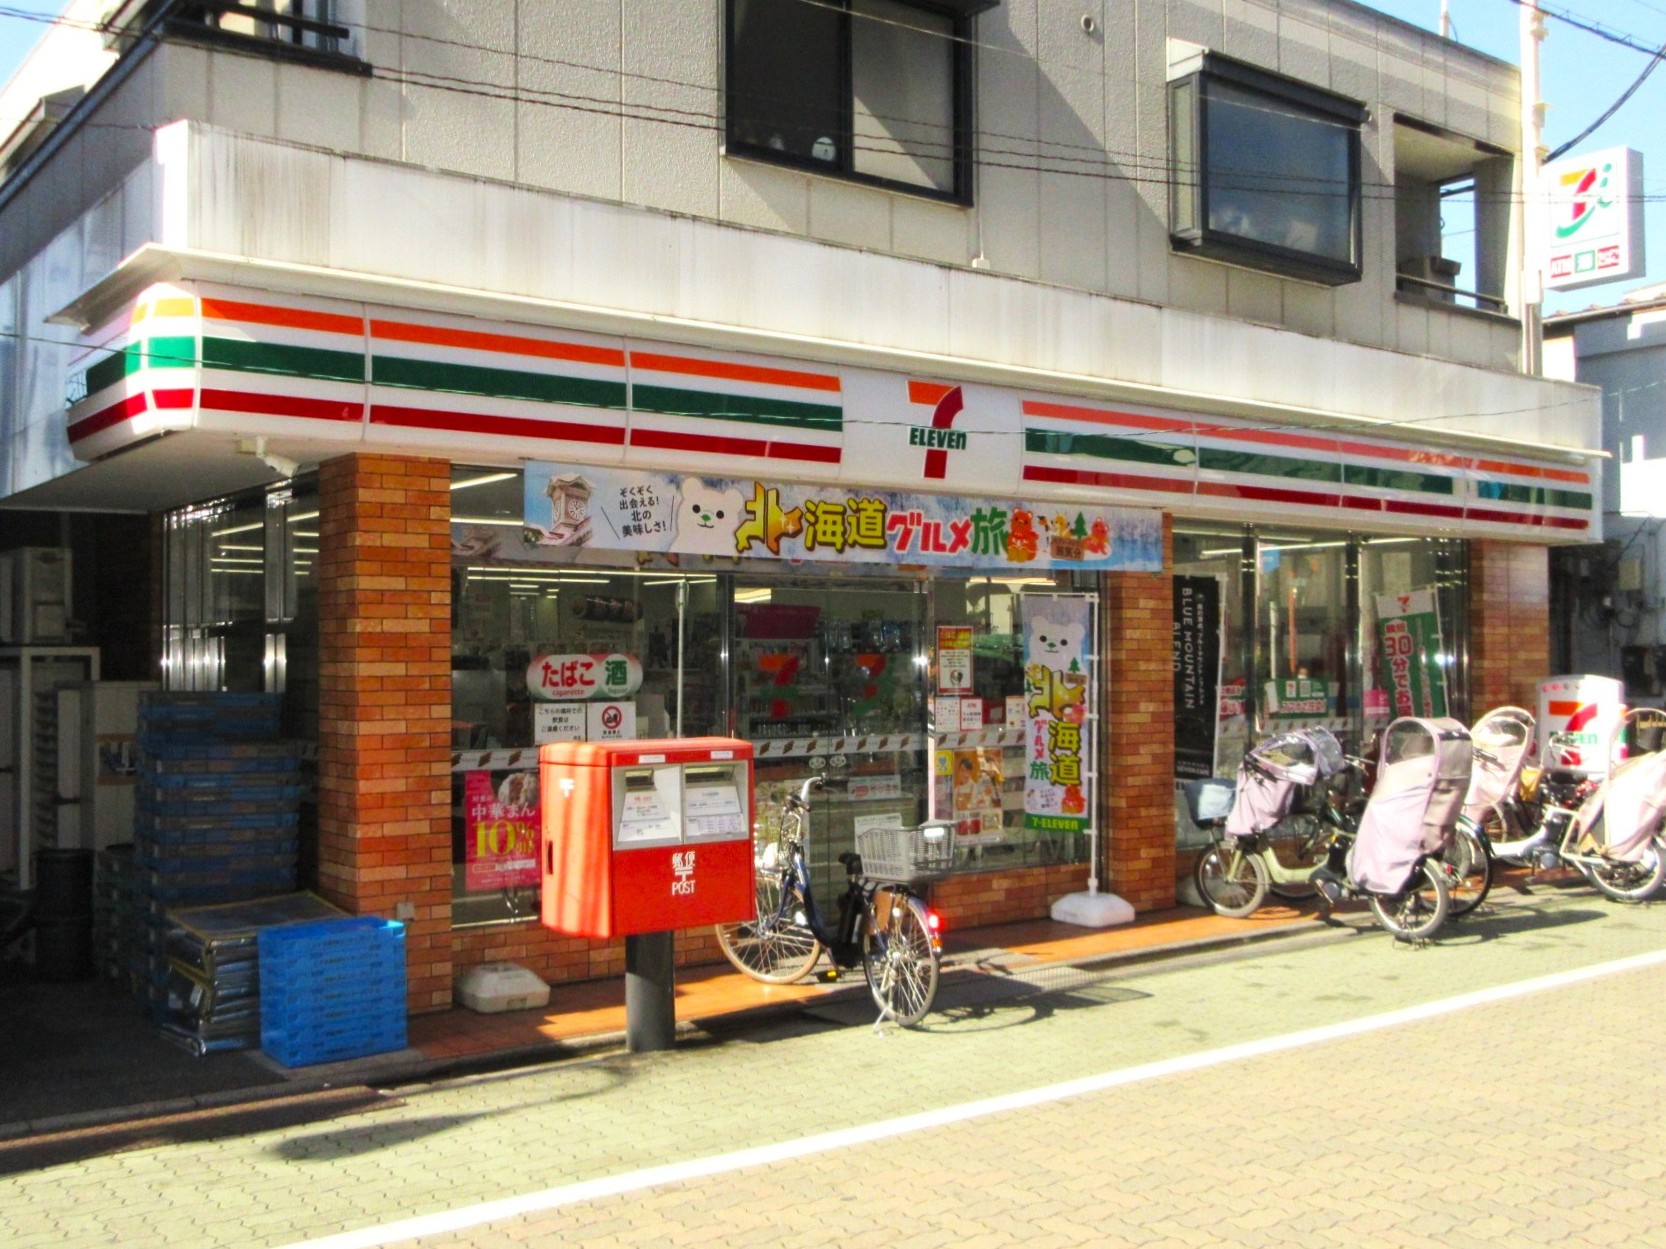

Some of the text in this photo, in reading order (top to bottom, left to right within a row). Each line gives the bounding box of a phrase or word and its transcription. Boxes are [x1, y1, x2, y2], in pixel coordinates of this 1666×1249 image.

[906, 380, 964, 479] 7
[631, 510, 652, 522] 北の
[1182, 588, 1195, 709] BLUE MOUNTAIN
[542, 660, 627, 687] たばこ 酒
[472, 802, 536, 821] 中華まん
[672, 851, 696, 868] 郵便
[672, 880, 696, 896] POST
